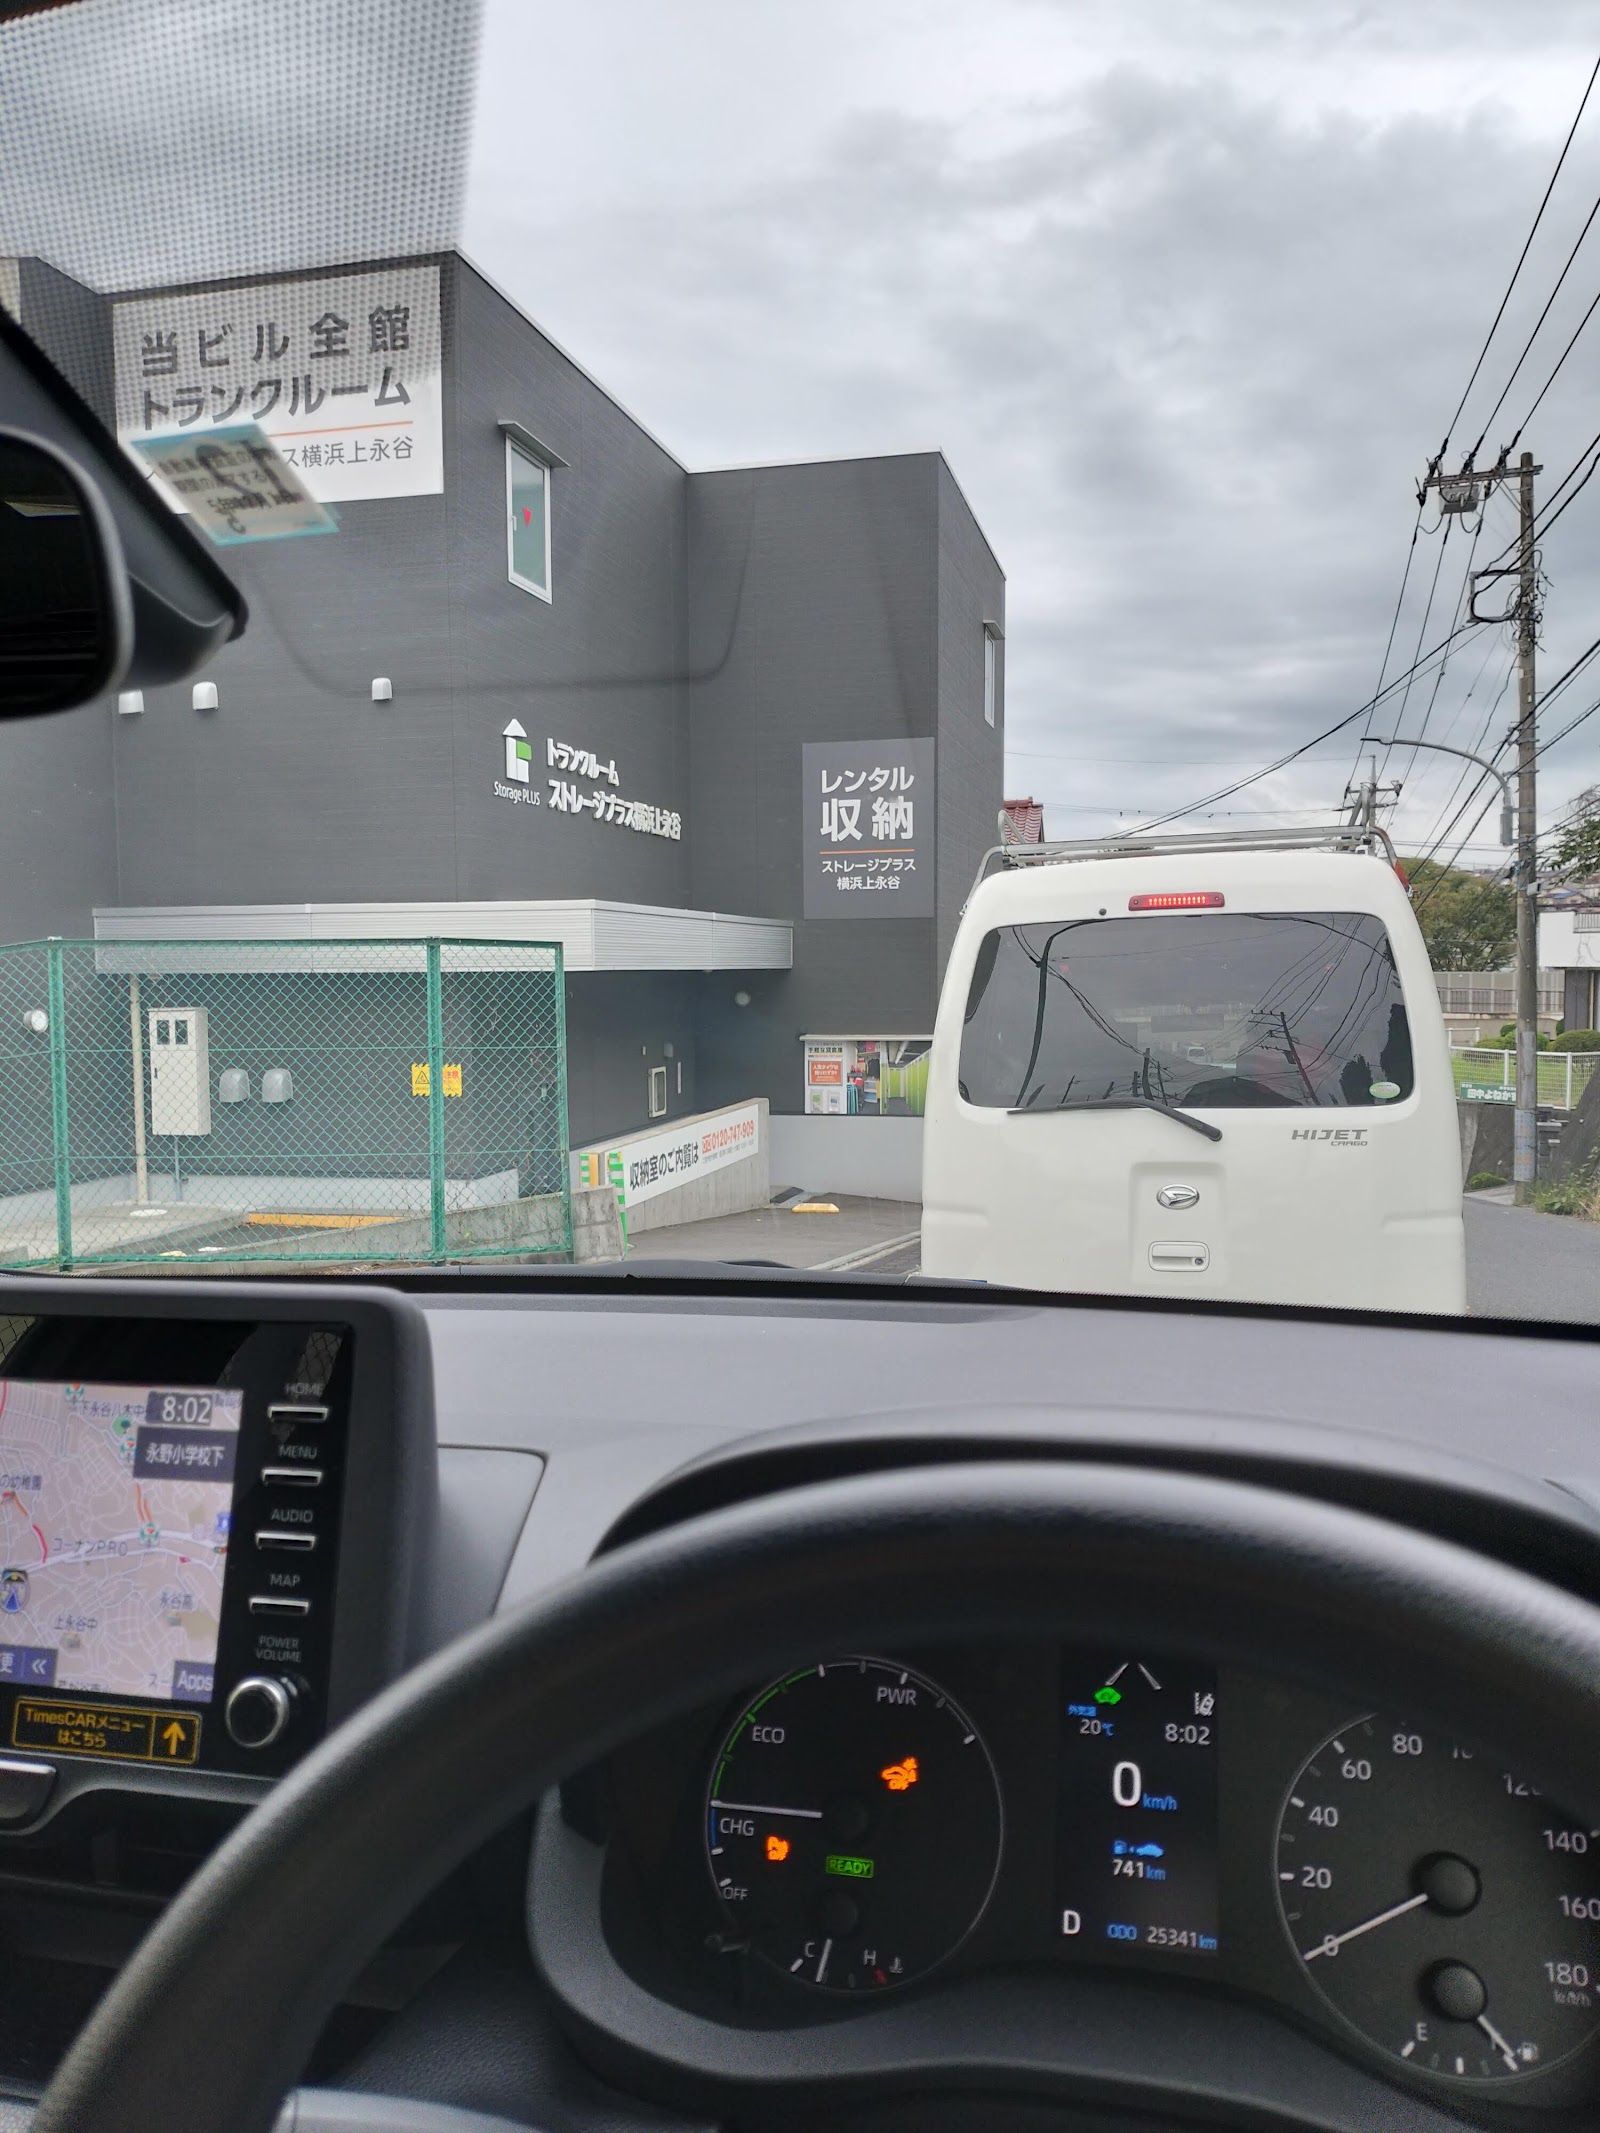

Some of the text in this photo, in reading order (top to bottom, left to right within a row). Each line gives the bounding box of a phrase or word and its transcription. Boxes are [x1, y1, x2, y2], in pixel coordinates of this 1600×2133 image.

[142, 304, 410, 377] 当ビル全館
[143, 366, 412, 431] トランクルーム
[282, 435, 414, 468] ス横浜上永谷
[546, 737, 620, 787] トランクルーム
[821, 766, 915, 794] レンタル
[493, 781, 541, 806] Storage PLUS
[548, 779, 682, 841] ストレージプラス横浜上永谷
[820, 795, 914, 842] 収納
[821, 858, 916, 873] ストレージプラス
[836, 876, 901, 890] 横浜上永谷
[1291, 1129, 1368, 1140] HIJET
[629, 1141, 699, 1191] 収納室のご内覧は
[285, 1382, 324, 1396] HOME
[161, 1396, 212, 1424] 8:02
[146, 1442, 224, 1467] 永野小学校下
[279, 1444, 318, 1460] MENU
[271, 1508, 314, 1523] AUDIO
[270, 1573, 300, 1587] MAP
[259, 1635, 299, 1649] POWER
[255, 1647, 302, 1662] VOLUME
[877, 1686, 917, 1706] PWR
[57, 1728, 107, 1748] はこちら
[752, 1726, 785, 1744] ECO
[1164, 1723, 1211, 1746] 8:02
[1392, 1734, 1422, 1757] 80
[1341, 1759, 1372, 1782] 60
[1112, 1761, 1142, 1807] 0
[719, 1817, 755, 1837] CHG
[1308, 1805, 1339, 1828] 40
[1543, 1829, 1588, 1855] 140
[828, 1859, 871, 1875] READY
[1301, 1866, 1332, 1889] 20
[723, 1886, 748, 1901] OFF
[1558, 1894, 1600, 1920] 160
[1063, 1909, 1081, 1935] D
[863, 1949, 876, 1966] H
[1543, 1961, 1589, 1988] 180
[1416, 2022, 1428, 2042] E
